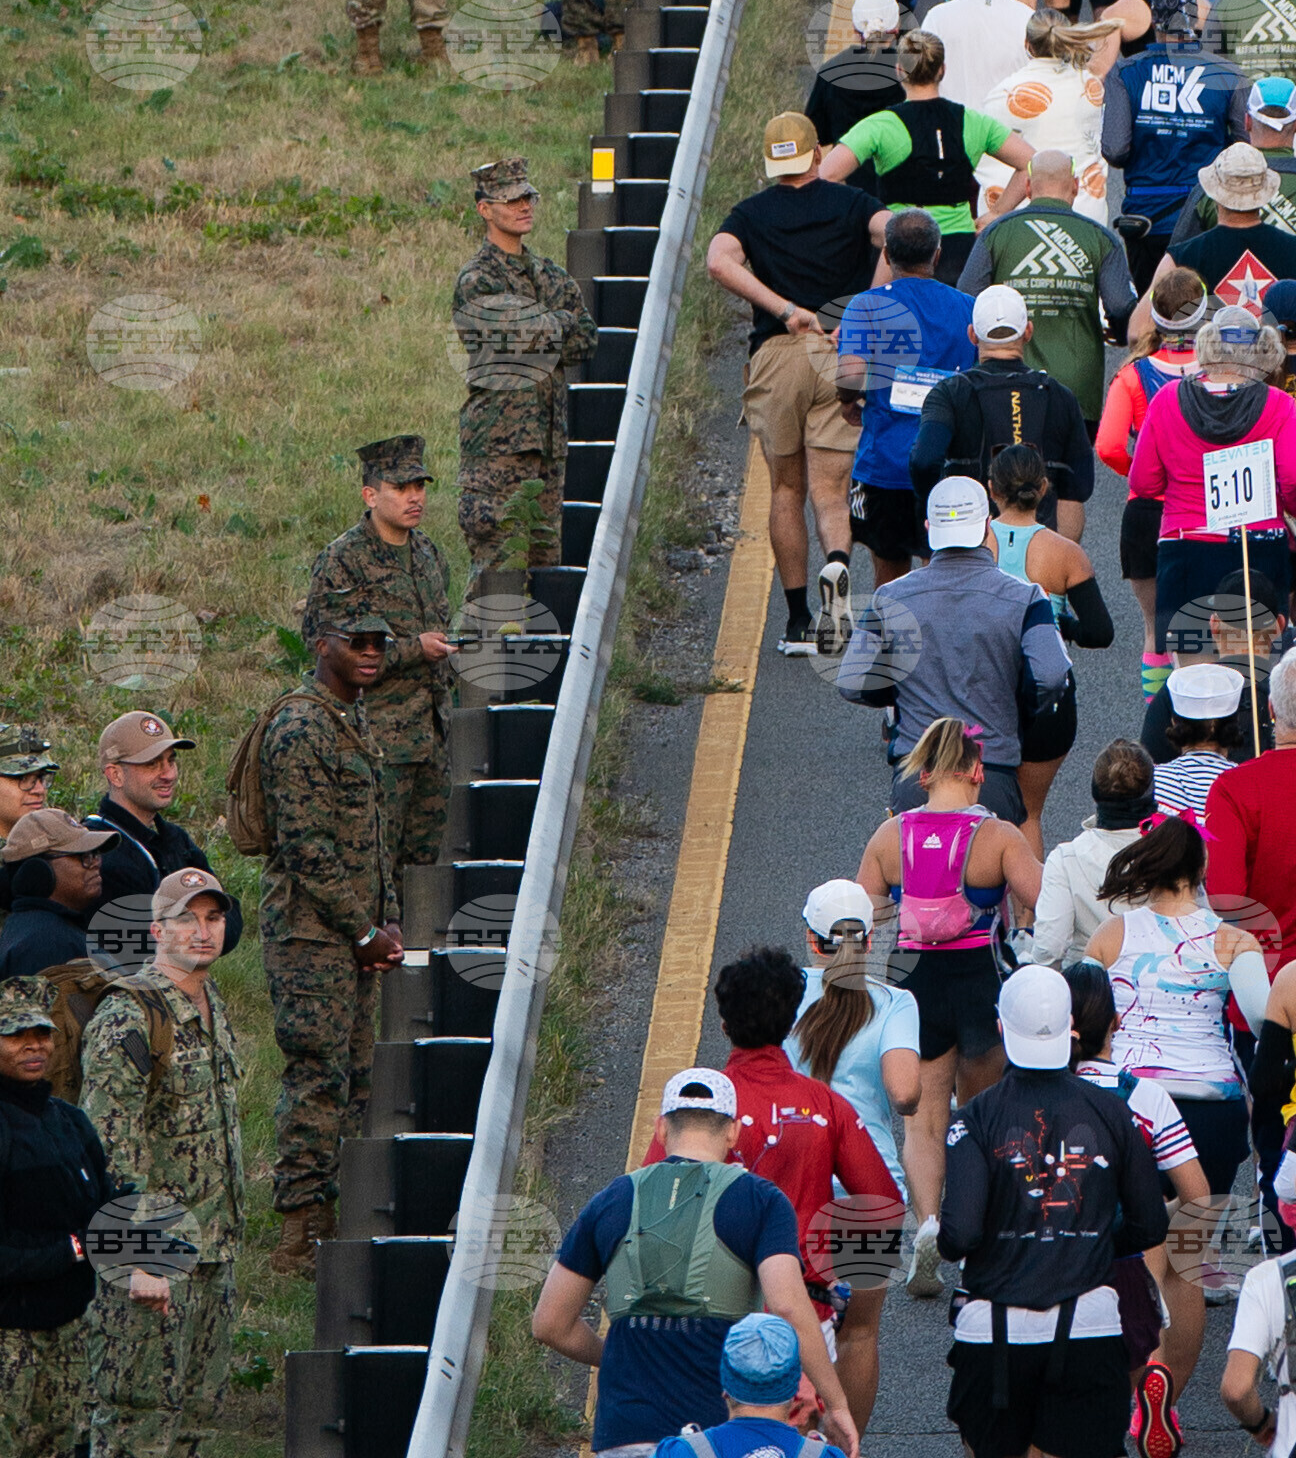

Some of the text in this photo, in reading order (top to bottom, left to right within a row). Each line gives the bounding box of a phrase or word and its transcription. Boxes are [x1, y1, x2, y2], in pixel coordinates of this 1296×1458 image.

[1152, 64, 1186, 84] MCM
[1011, 391, 1022, 445] NATHA
[1204, 440, 1270, 468] ELEVATED
[1210, 466, 1253, 510] 5:10
